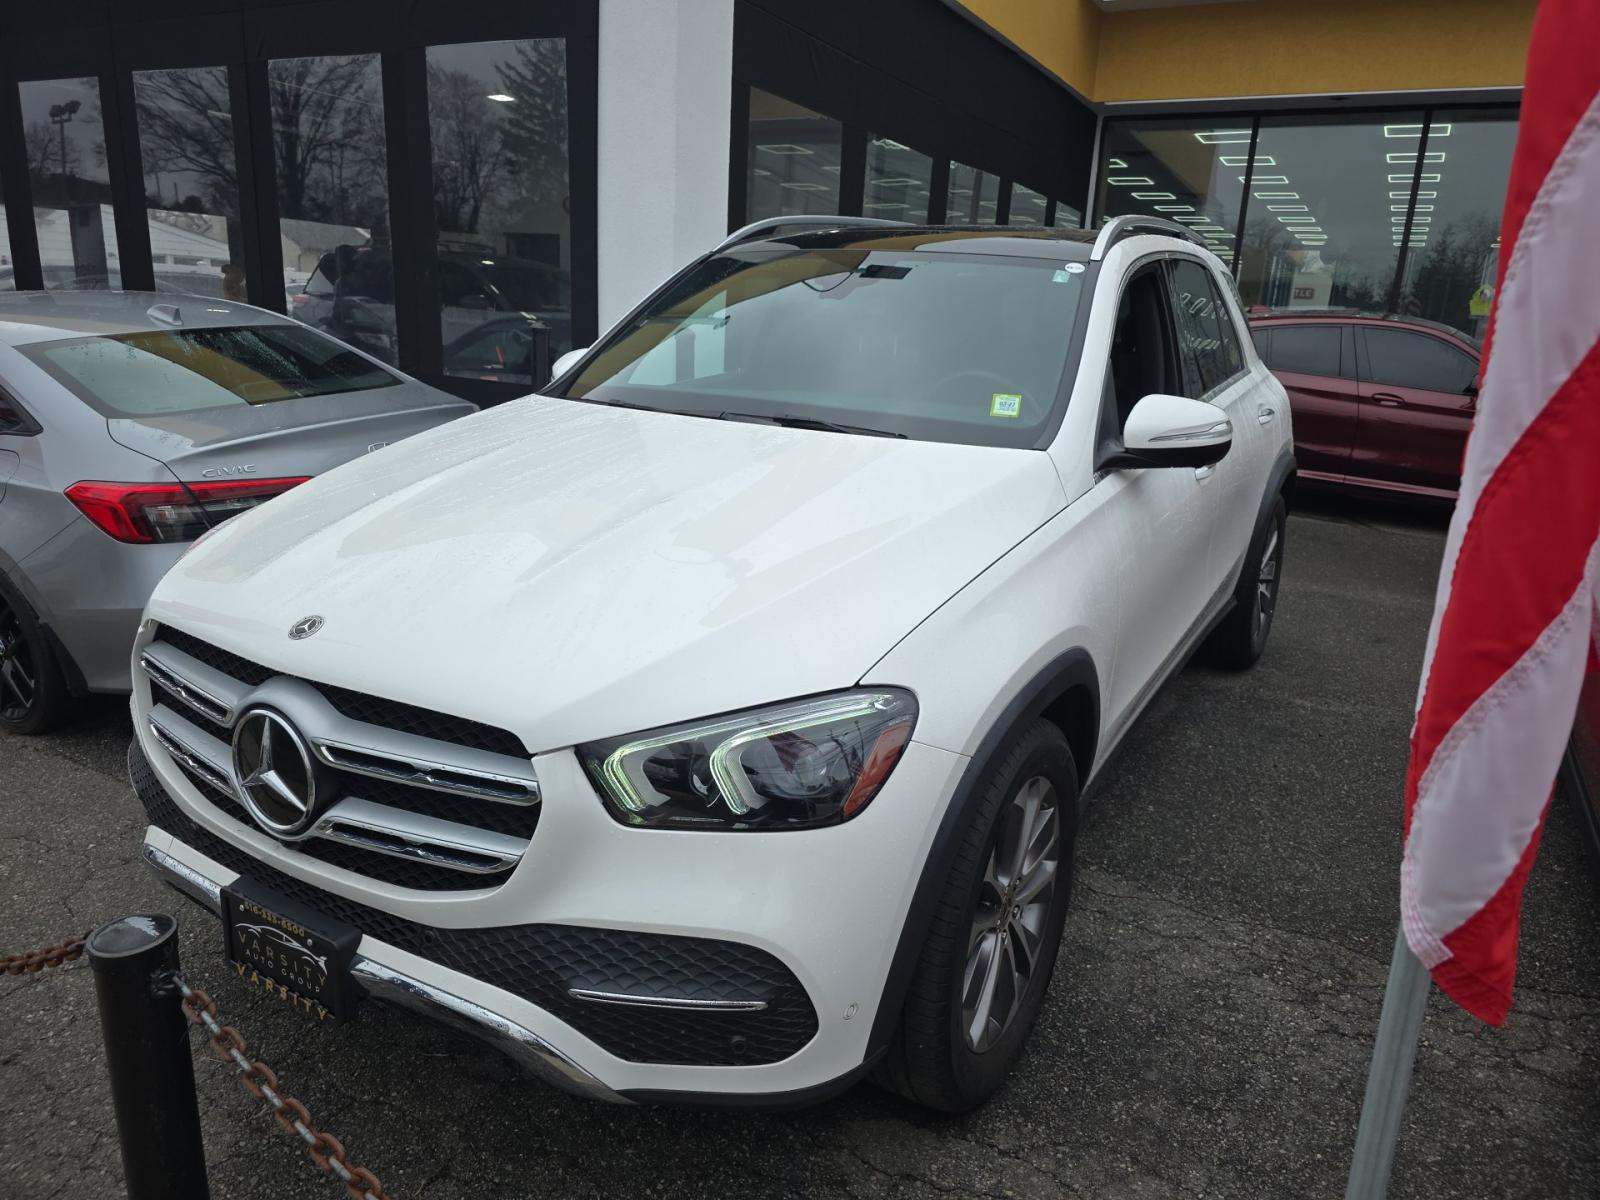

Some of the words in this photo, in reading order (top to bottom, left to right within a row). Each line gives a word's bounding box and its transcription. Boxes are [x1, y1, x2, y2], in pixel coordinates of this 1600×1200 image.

[202, 463, 257, 478] CIVIC
[238, 931, 326, 987] VARSITY
[246, 948, 274, 969] AUTO
[236, 961, 329, 1021] VARSITY
